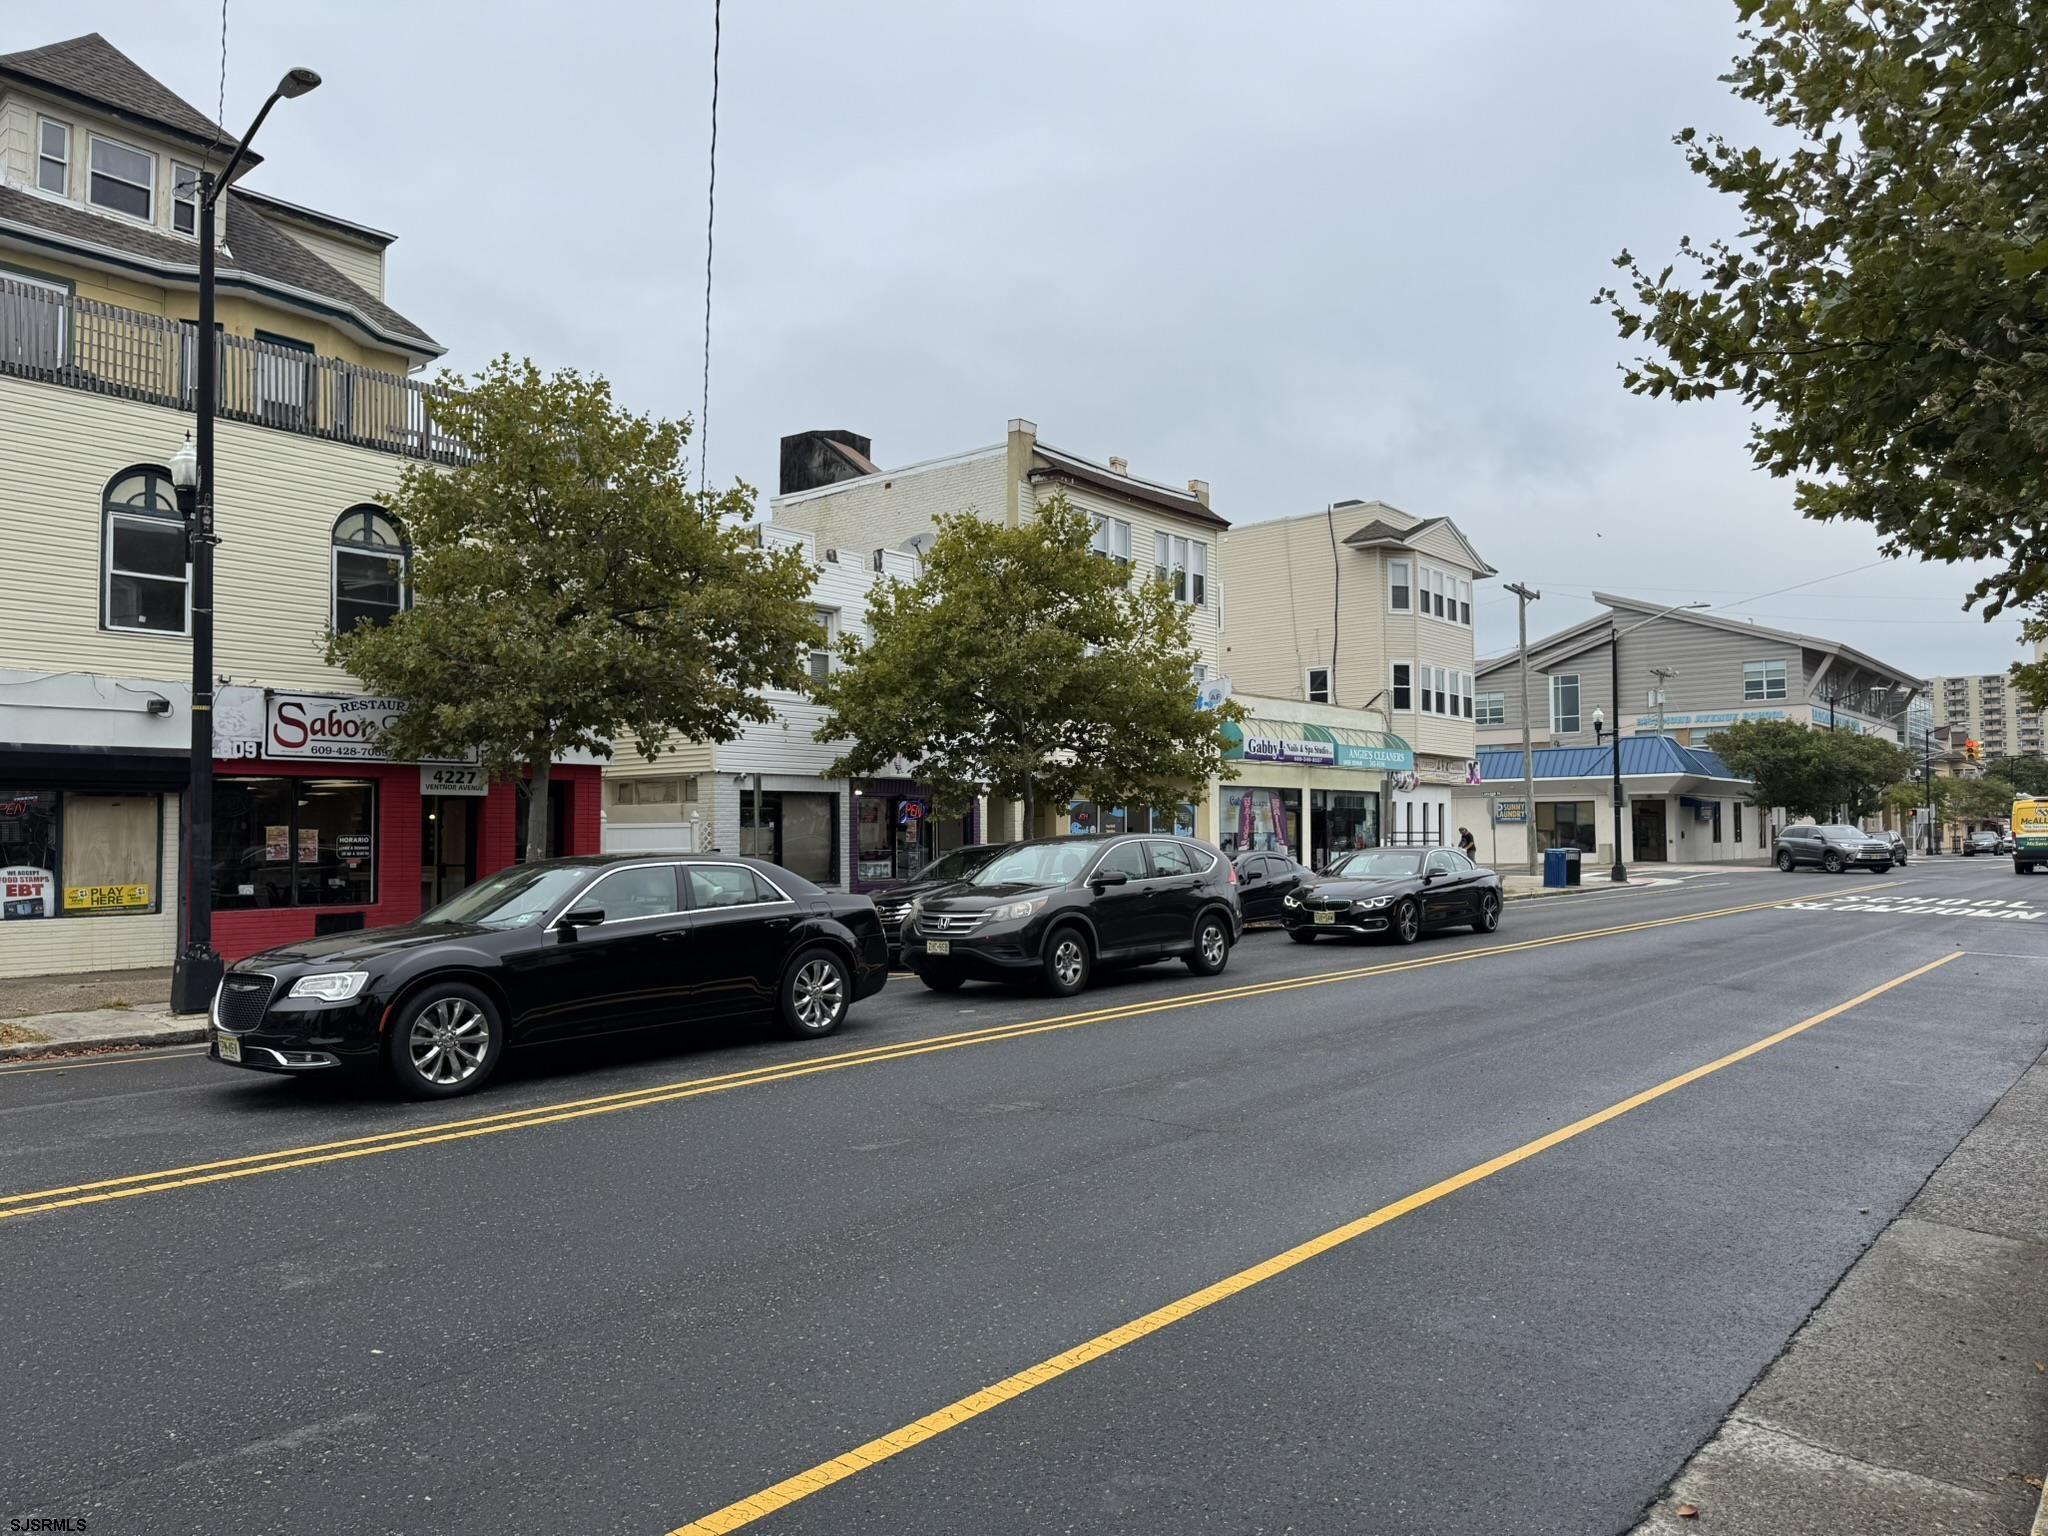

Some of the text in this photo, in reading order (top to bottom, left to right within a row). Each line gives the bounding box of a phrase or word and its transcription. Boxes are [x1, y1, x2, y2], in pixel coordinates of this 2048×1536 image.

[1248, 739, 1278, 758] Gabby
[1374, 751, 1405, 762] CLEANERS
[433, 770, 476, 784] 4227
[425, 783, 456, 791] VENTNOR
[6, 884, 44, 897] EBT
[91, 887, 124, 897] PLAY
[91, 896, 123, 906] HERE
[1833, 896, 2034, 909] SCHOOL
